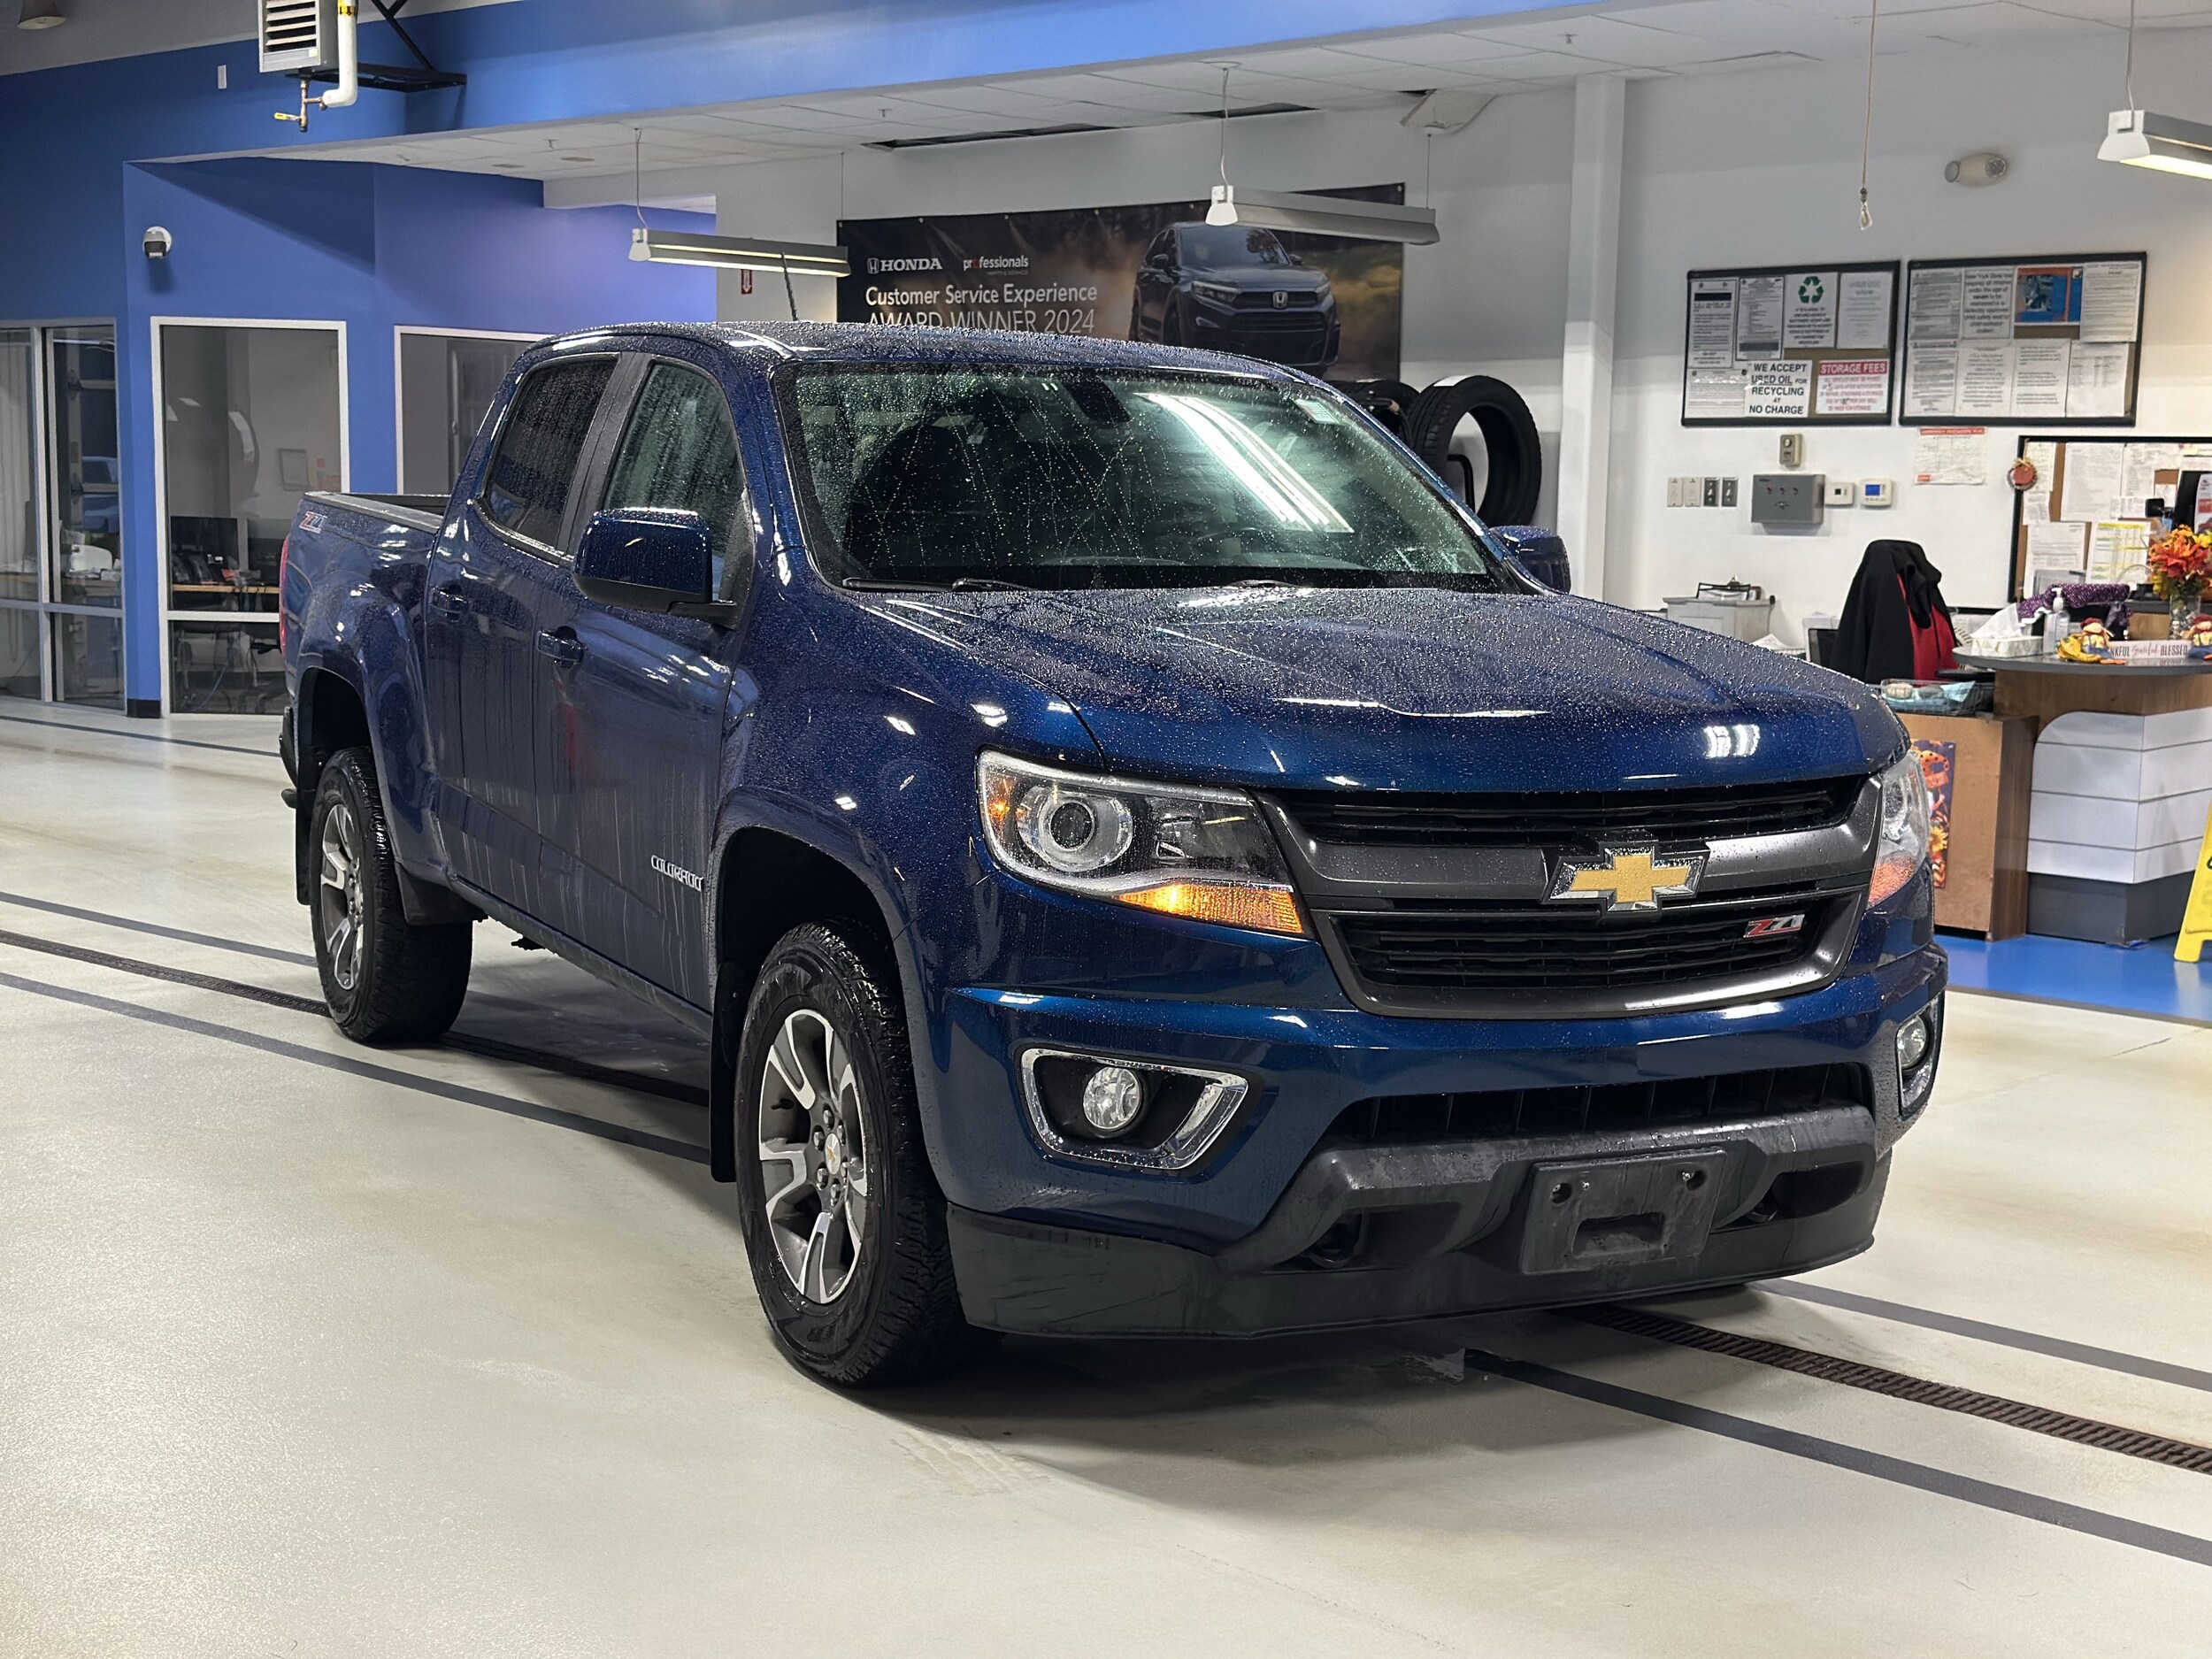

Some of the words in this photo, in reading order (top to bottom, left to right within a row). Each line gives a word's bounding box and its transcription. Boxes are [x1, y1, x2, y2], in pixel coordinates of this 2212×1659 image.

[880, 257, 943, 273] HONDA
[865, 286, 940, 306] Customer
[945, 284, 999, 304] Service
[1003, 282, 1097, 308] Experience
[869, 311, 943, 327] AWARD
[950, 310, 1036, 334] WINNER
[1044, 308, 1095, 334] 2024
[1820, 364, 1861, 373] STORAGE
[1863, 363, 1886, 373] FEES
[1752, 375, 1776, 384] USED
[1778, 375, 1793, 384] OIL
[1752, 387, 1804, 396] RECYCLING
[1765, 405, 1803, 414] CHARGE
[299, 511, 327, 534] Z71
[2110, 646, 2130, 657] NKFUL
[2160, 645, 2188, 657] BLESSED
[650, 854, 704, 892] COLORADO
[1743, 914, 1805, 938] Z71
